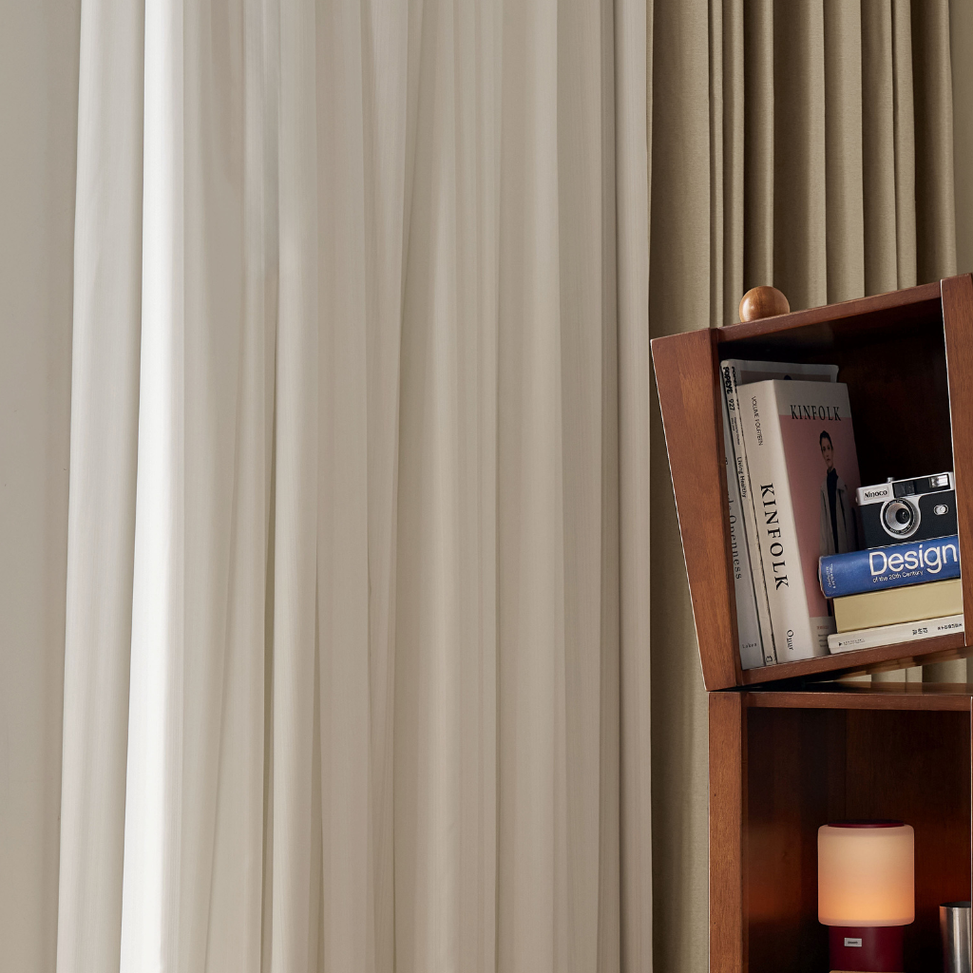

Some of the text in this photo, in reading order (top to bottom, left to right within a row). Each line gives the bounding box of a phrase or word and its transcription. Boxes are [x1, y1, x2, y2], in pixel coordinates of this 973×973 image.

[723, 366, 733, 394] POPEYE
[751, 396, 763, 446] VOLUME FOURTEEN
[790, 404, 842, 422] KINFOLK
[760, 483, 790, 591] KINFOLK
[869, 544, 958, 576] Design
[889, 573, 901, 581] 20th
[902, 570, 923, 578] Century
